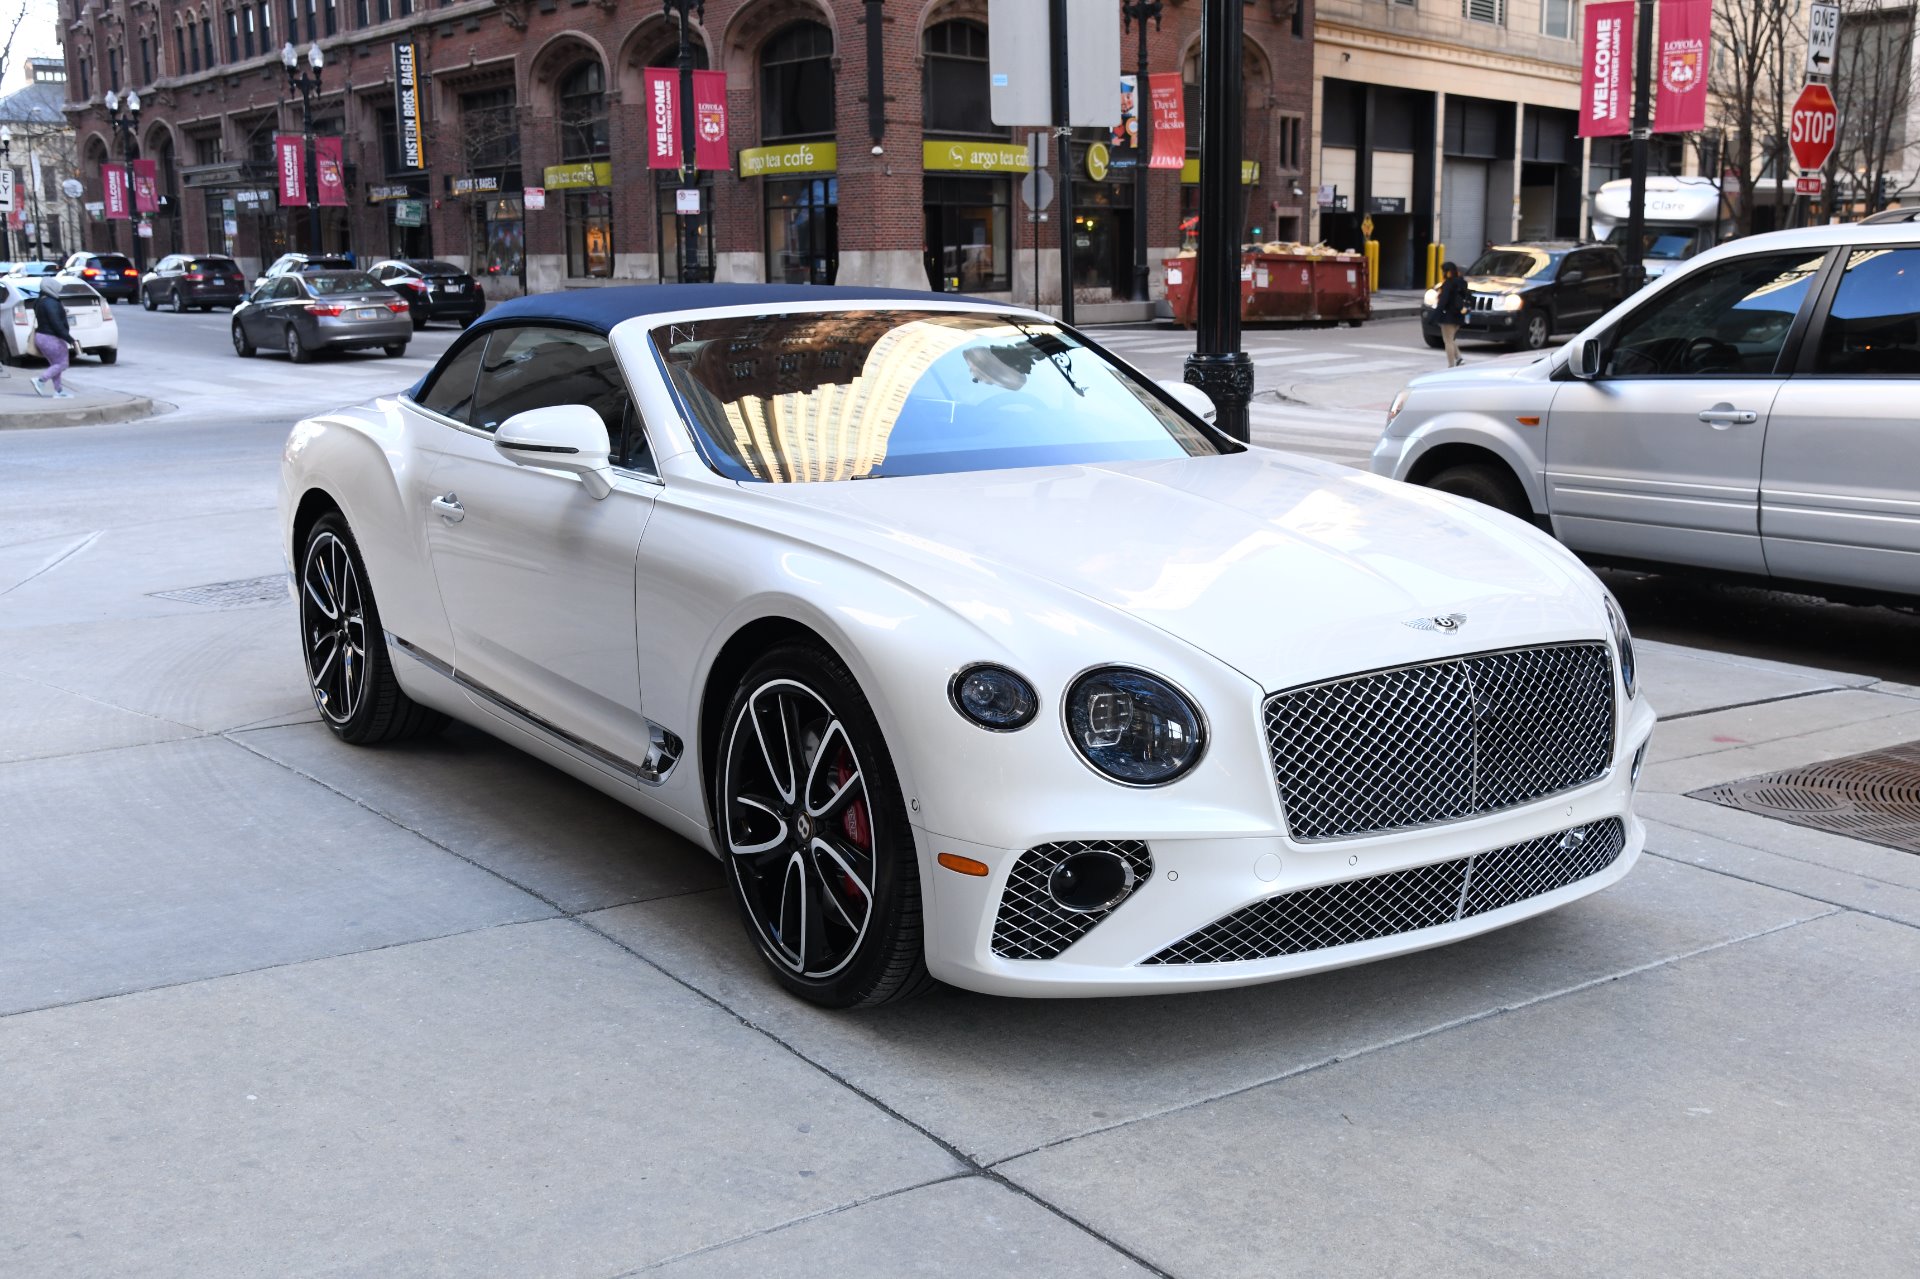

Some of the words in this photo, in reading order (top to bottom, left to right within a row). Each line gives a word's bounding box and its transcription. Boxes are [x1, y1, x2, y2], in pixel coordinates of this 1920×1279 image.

[1814, 11, 1836, 28] ONE
[1612, 18, 1622, 56] CAMPUS
[1664, 39, 1703, 50] LOYOLA
[1812, 29, 1834, 47] WAY
[400, 44, 414, 86] BAGELS
[1592, 18, 1612, 120] WELCOME
[1610, 57, 1620, 89] TOWER
[654, 80, 667, 156] WELCOME
[1154, 99, 1178, 110] David
[1610, 90, 1618, 119] WATER
[1792, 110, 1835, 144] STOP
[405, 120, 418, 167] EINSTEIN
[765, 154, 780, 167] tea
[784, 145, 814, 166] café
[283, 145, 295, 198] WELCOME
[970, 152, 998, 169] argo
[1000, 151, 1014, 165] tea
[1652, 201, 1685, 211] Clare
